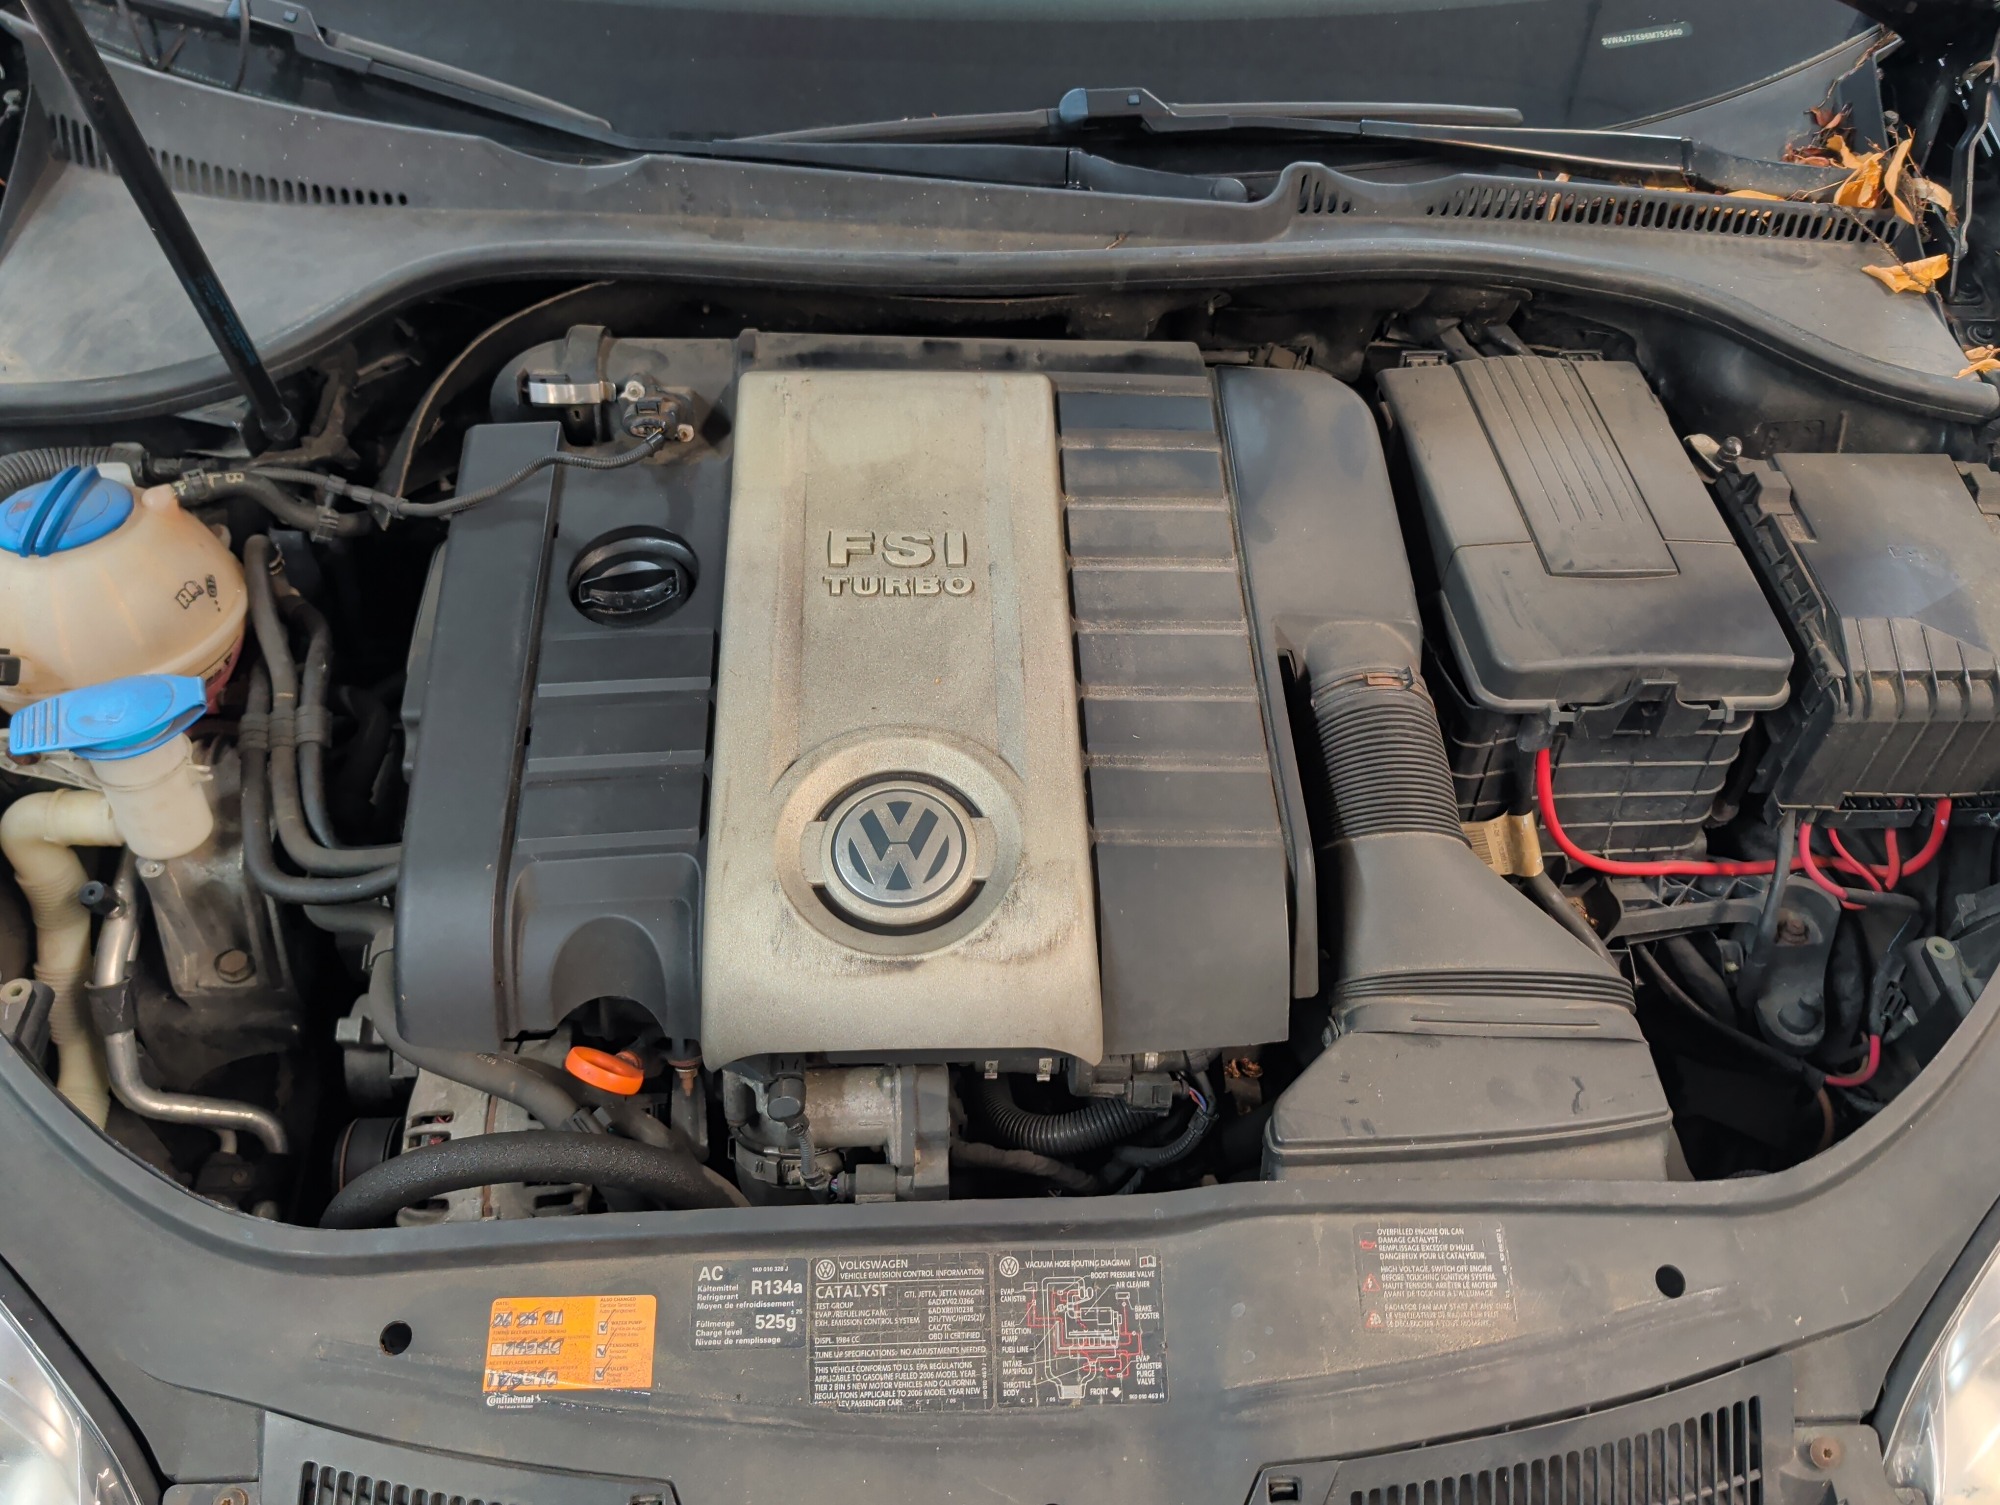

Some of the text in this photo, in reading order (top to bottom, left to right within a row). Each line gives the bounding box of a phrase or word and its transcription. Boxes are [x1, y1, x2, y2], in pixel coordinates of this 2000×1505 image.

[827, 529, 969, 568] FSI
[823, 573, 975, 597] TURBO
[839, 1259, 908, 1269] VOLKSWAGEN
[1055, 1260, 1070, 1268] HOSE
[698, 1265, 723, 1281] AC
[840, 1269, 984, 1280] VEHICLE EMISSION CONTROL INFORMATION
[1091, 1271, 1108, 1279] BOOST
[1441, 1273, 1470, 1281] IGNITION
[698, 1284, 739, 1292] Kältemittel
[751, 1279, 803, 1295] R134a
[1463, 1281, 1471, 1289] LE
[1472, 1281, 1497, 1289] MOTEUR
[816, 1284, 888, 1299] CATALYST
[939, 1289, 957, 1297] JETTA
[1001, 1295, 1026, 1303] CANISTER
[1135, 1304, 1152, 1312] BRAKE
[895, 1316, 920, 1324] SYSTEM
[1135, 1312, 1159, 1320] BOOSTER
[696, 1320, 735, 1328] Füllmenge
[755, 1314, 797, 1332] 525g
[836, 1336, 850, 1344] 1984
[928, 1332, 980, 1341] OBD CERTIFIED
[1002, 1335, 1018, 1343] PUMP
[736, 1337, 781, 1345] remplissage
[912, 1347, 960, 1355] ADJUSTMENTS
[962, 1346, 986, 1354] NEEDED
[1136, 1354, 1150, 1362] EVAP
[856, 1364, 891, 1372] CONFORMS
[916, 1363, 928, 1371] EPA
[930, 1361, 973, 1370] REGULATIONS
[1136, 1362, 1162, 1370] CANISTER
[1003, 1367, 1033, 1375] MANIFOLD
[1137, 1370, 1154, 1378] PURGE
[863, 1373, 893, 1381] GASOLINE
[895, 1372, 918, 1380] FUELED
[960, 1370, 976, 1378] YEAR
[852, 1382, 867, 1390] NEW
[869, 1381, 892, 1389] MOTOR
[924, 1380, 937, 1388] AND
[939, 1379, 976, 1387] CALIFORNIA
[1003, 1381, 1031, 1389] THROTTLE
[1137, 1377, 1155, 1385] VALVE
[860, 1390, 896, 1398] APPLICABLE
[908, 1389, 923, 1397] 2006
[924, 1388, 947, 1396] MODEL
[966, 1387, 980, 1395] NEW
[1003, 1389, 1020, 1397] BODY
[1090, 1387, 1109, 1395] FRONT
[486, 1394, 534, 1406] Continental
[851, 1399, 886, 1407] PASSENGER
